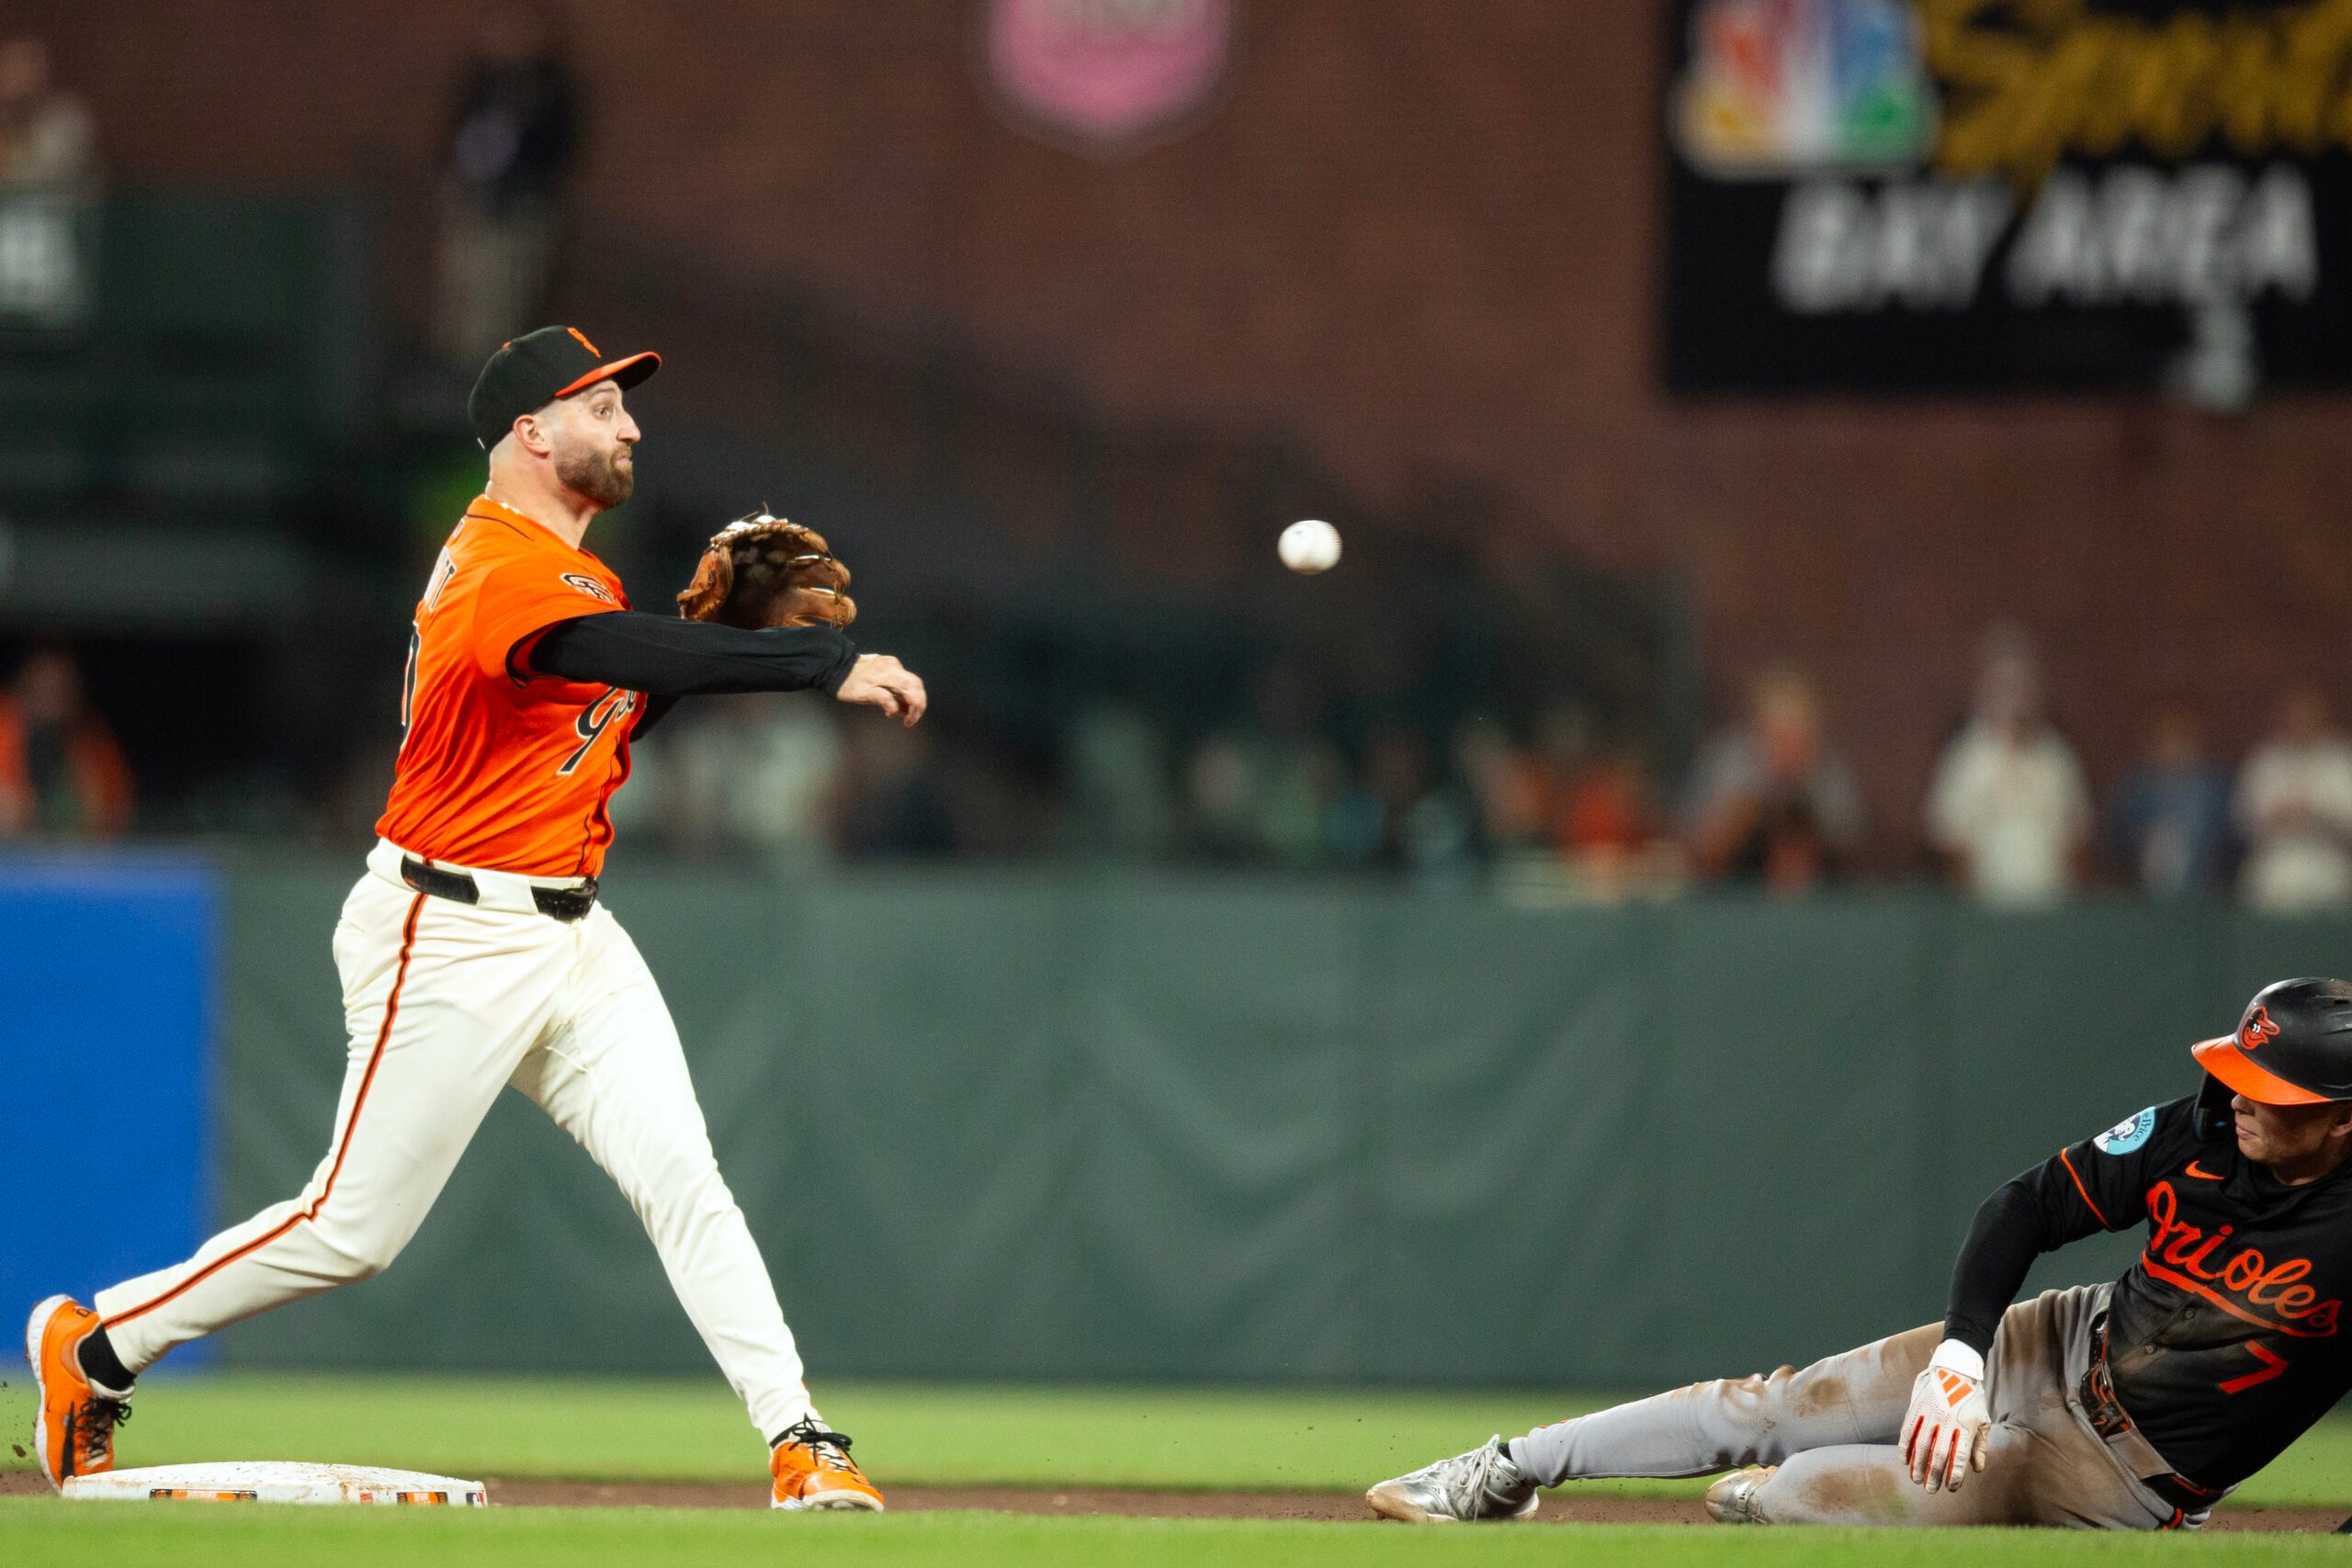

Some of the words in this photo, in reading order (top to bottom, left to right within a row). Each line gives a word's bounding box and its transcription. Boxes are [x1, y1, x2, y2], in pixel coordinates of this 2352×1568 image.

[1773, 176, 2014, 314] BAY
[2007, 165, 2319, 306] AREA
[2144, 1180, 2342, 1337] Orioles
[2218, 1339, 2290, 1394] 7
